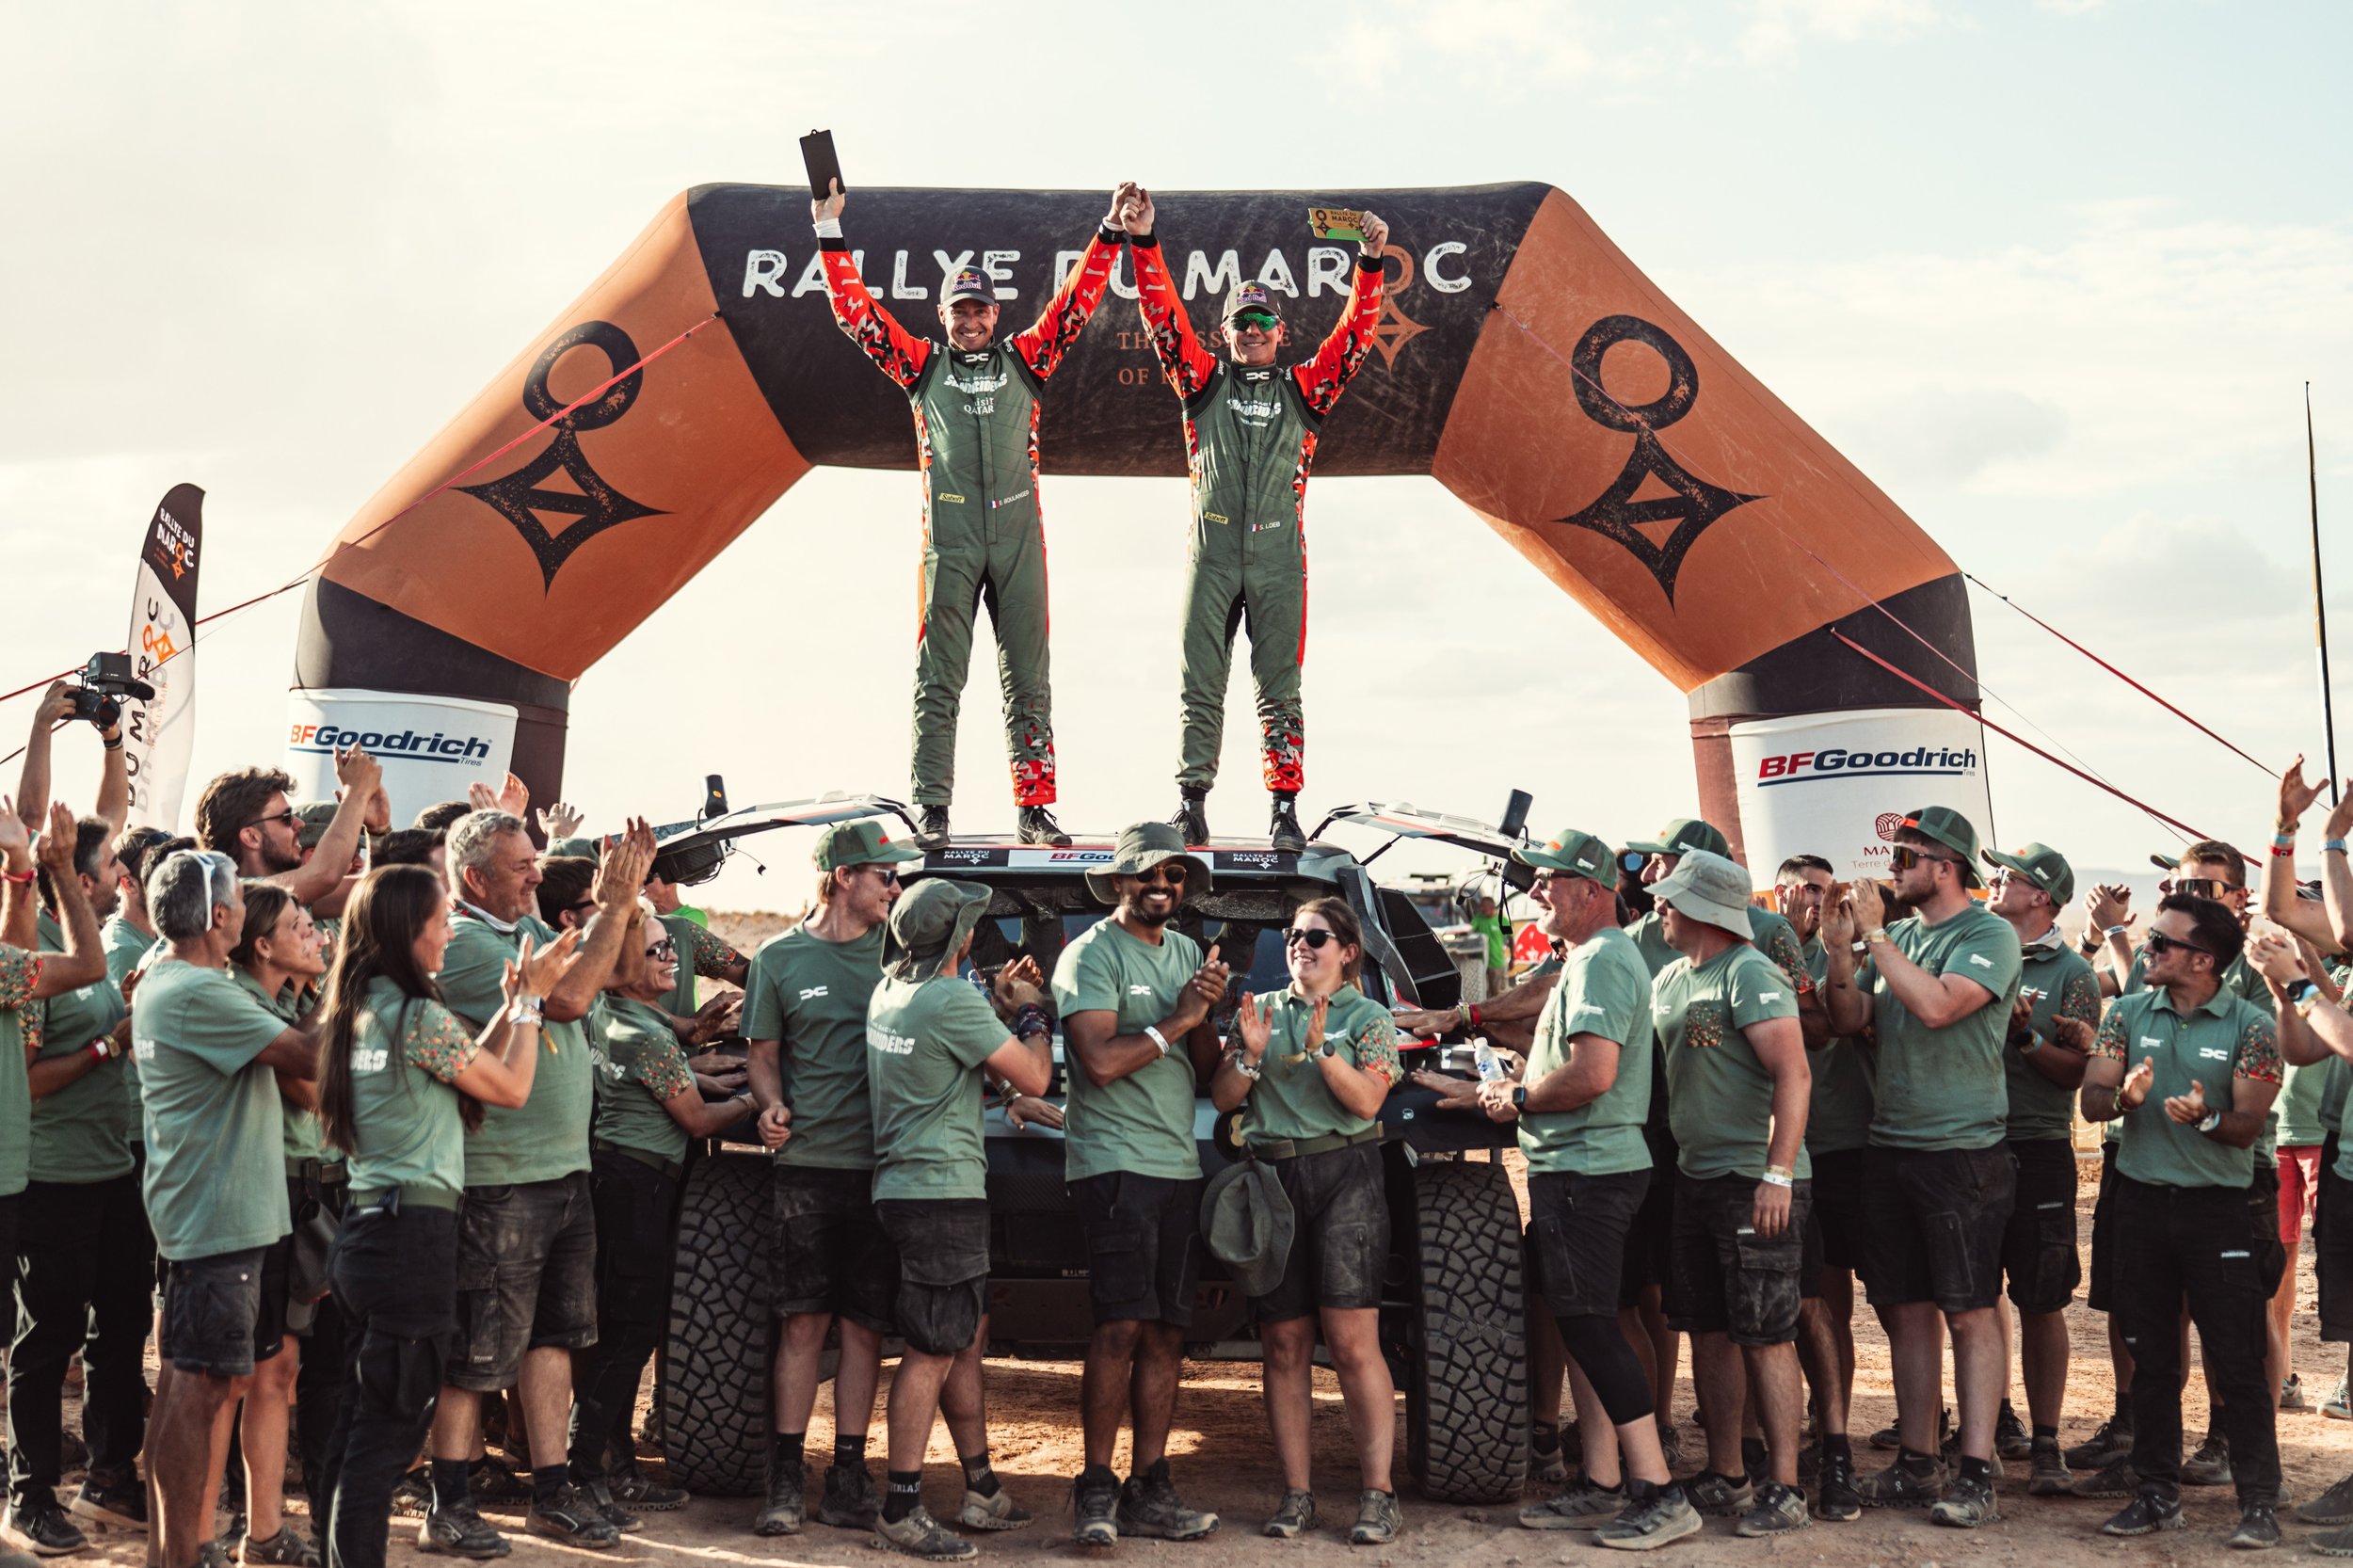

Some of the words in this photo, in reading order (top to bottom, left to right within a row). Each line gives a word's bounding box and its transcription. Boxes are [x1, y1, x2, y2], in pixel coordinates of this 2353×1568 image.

[1118, 369, 1149, 386] OF
[963, 404, 994, 415] QATAR
[160, 507, 183, 538] RALLYE
[182, 530, 195, 549] DU
[129, 596, 159, 744] MROC
[290, 724, 490, 759] BFGoodrich
[458, 757, 483, 767] Tires
[1758, 746, 1976, 779] BFGoodrich
[1851, 859, 1881, 869] Terre
